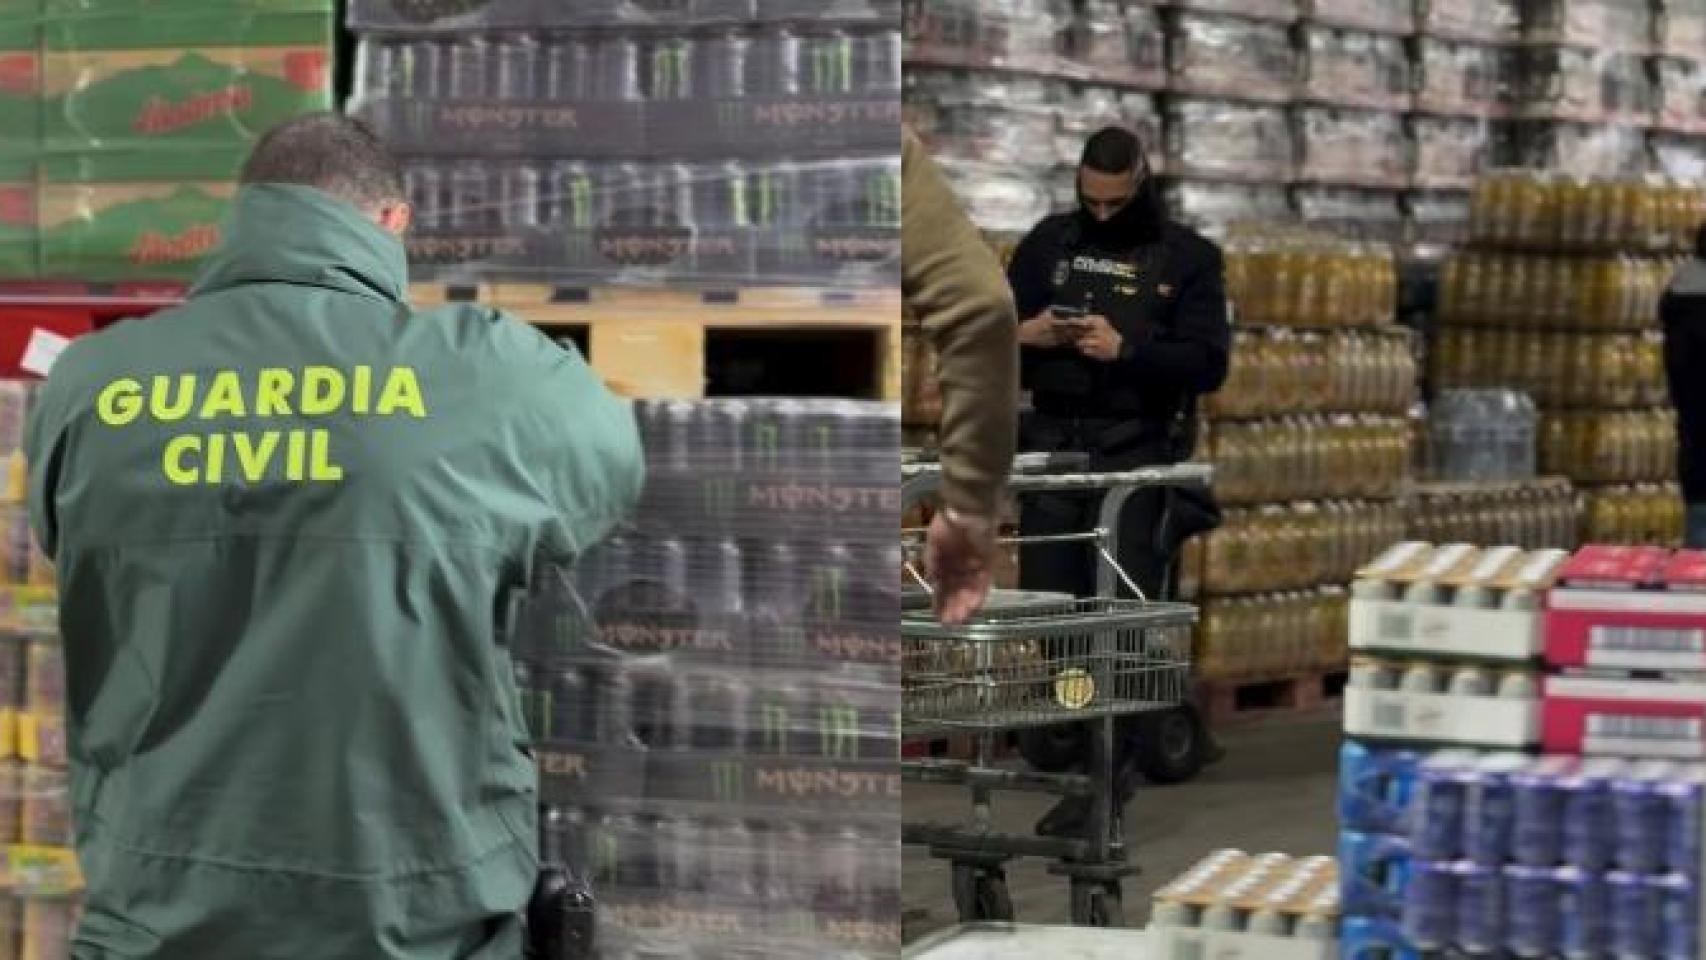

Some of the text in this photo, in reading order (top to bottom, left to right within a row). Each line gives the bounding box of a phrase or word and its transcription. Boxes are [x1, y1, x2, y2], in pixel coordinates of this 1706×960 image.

[441, 105, 577, 128] MONSTER
[97, 364, 427, 426] GUARDIA
[162, 428, 344, 484] CIVIL
